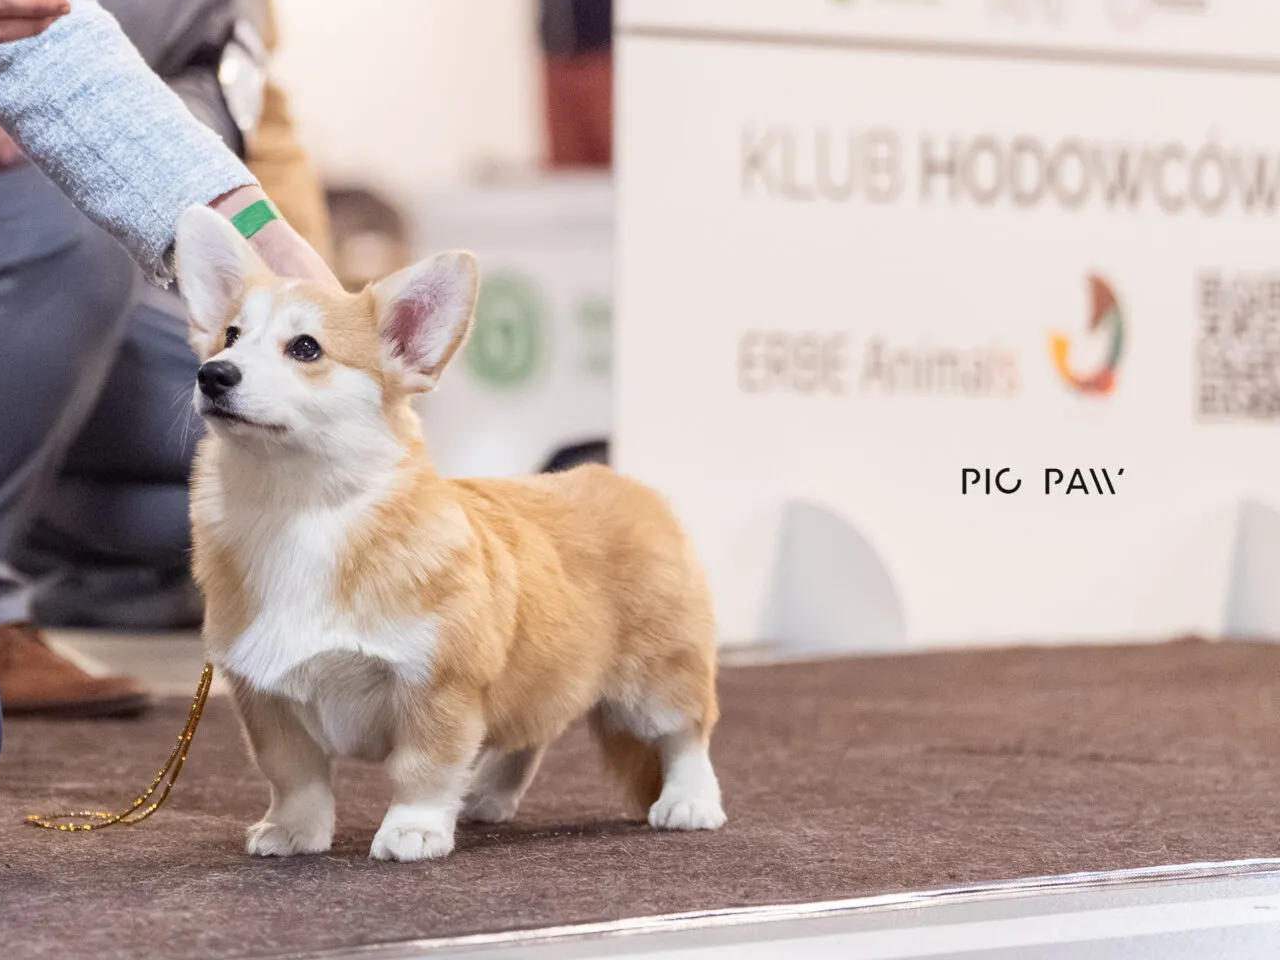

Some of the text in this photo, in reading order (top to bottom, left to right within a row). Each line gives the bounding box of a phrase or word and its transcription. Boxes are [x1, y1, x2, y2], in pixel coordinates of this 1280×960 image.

[741, 130, 901, 203] KLUB
[738, 331, 1020, 397] ERBE Animals
